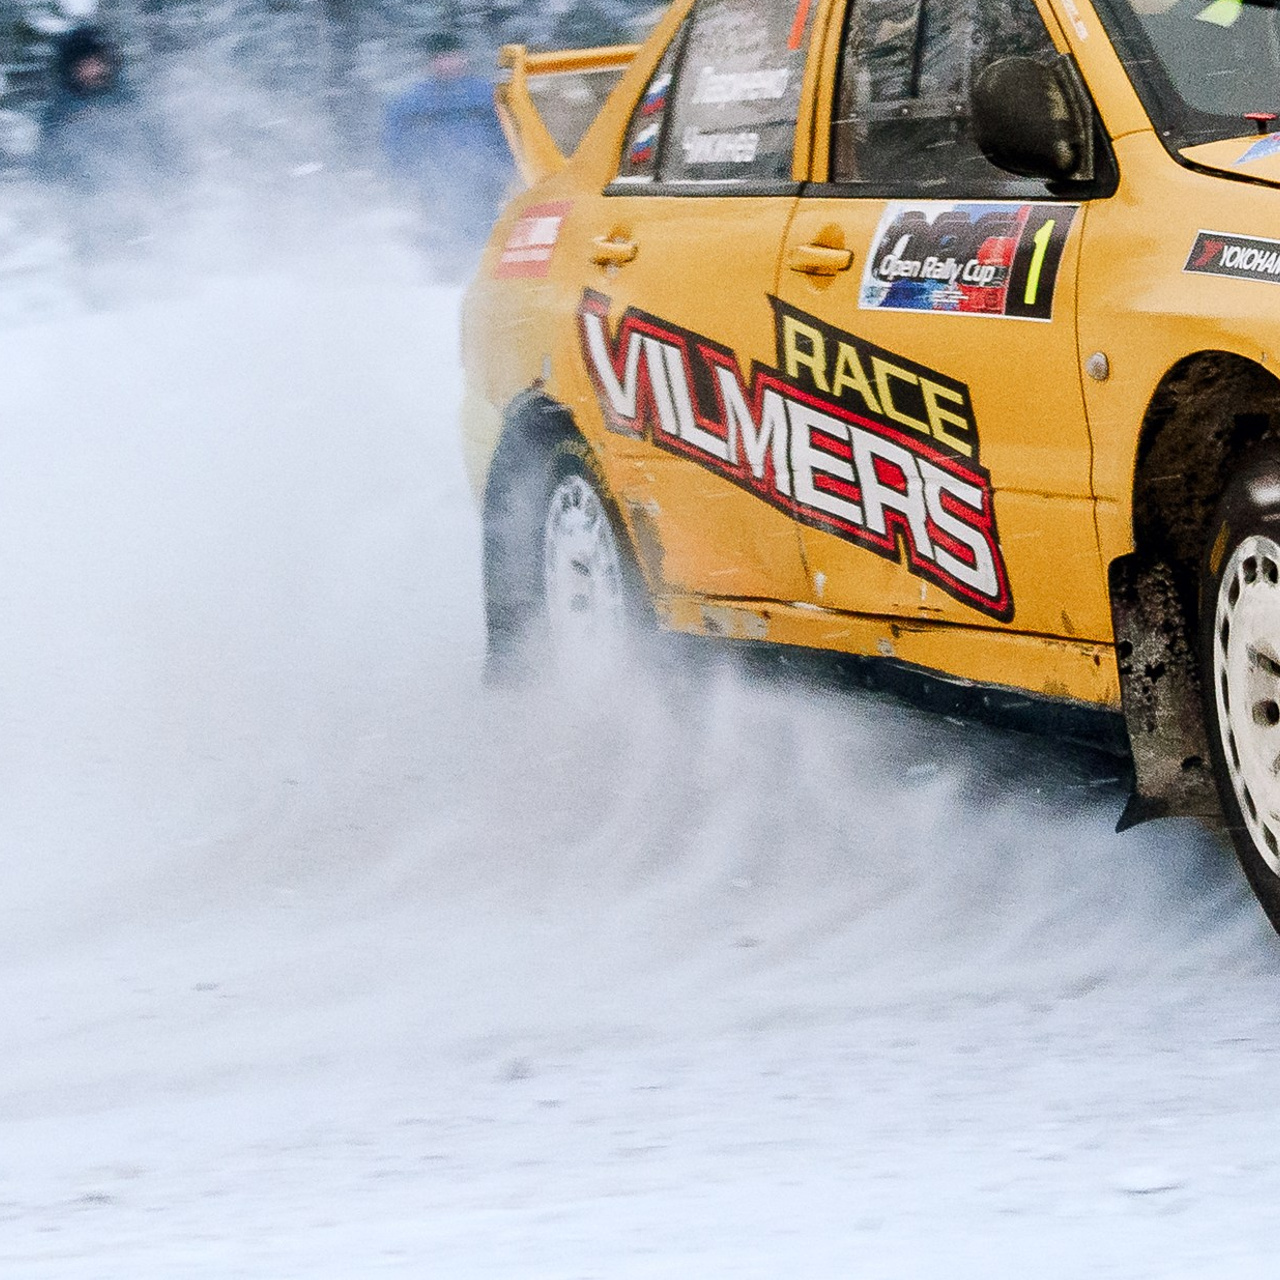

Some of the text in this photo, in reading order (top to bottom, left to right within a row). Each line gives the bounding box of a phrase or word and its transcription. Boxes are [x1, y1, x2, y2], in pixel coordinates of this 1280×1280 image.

[878, 254, 996, 286] Open Rally Cup
[1024, 219, 1055, 305] 1
[782, 314, 973, 458] RACE
[581, 311, 999, 598] VILMERS
